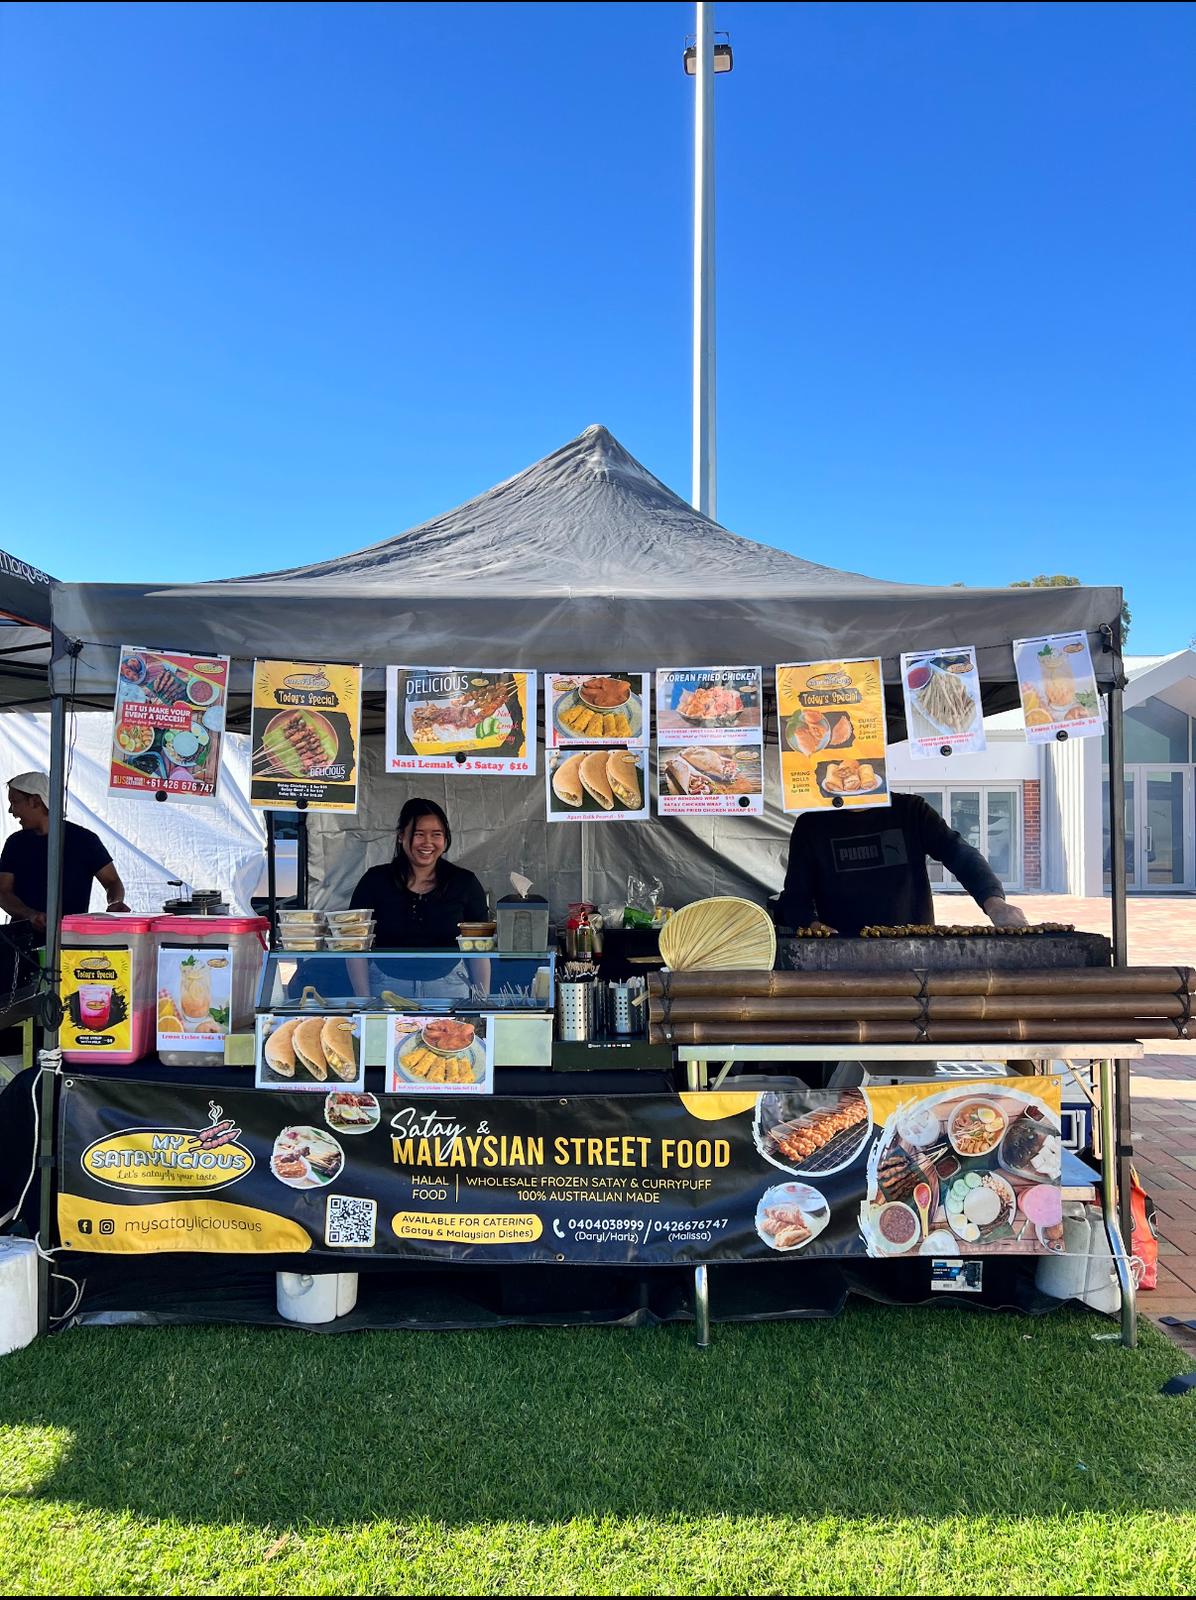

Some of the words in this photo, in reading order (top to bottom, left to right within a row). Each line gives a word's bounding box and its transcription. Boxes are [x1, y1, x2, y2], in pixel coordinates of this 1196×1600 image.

[663, 673, 696, 682] KOREAN
[697, 673, 721, 682] FRIED
[722, 672, 757, 681] CHICKEN
[406, 675, 469, 695] DELICIOUS
[278, 691, 305, 705] Today's
[308, 692, 335, 706] Special
[803, 693, 829, 705] Today's
[831, 691, 858, 704] Special
[125, 703, 138, 712] LET
[149, 706, 169, 714] MAKE
[170, 708, 191, 716] YOUR
[124, 711, 147, 719] EVENT
[149, 712, 154, 720] A
[155, 713, 186, 723] SUCCESS!
[309, 766, 346, 777] DELICIOUS
[392, 759, 416, 769] Nasi
[418, 759, 454, 769] Lemak
[465, 761, 472, 770] 3
[474, 760, 504, 772] Satay
[509, 762, 529, 770] $16
[146, 779, 160, 788] +61
[163, 780, 179, 790] 426
[182, 781, 197, 791] 676
[199, 783, 214, 793] 747
[839, 845, 879, 861] PUMA
[76, 970, 95, 979] Today's
[97, 970, 115, 979] Special
[390, 1107, 467, 1161] Satay
[476, 1120, 491, 1135] &
[152, 1135, 185, 1151] MY
[392, 1135, 544, 1168] MALAYSIAN
[554, 1135, 652, 1168] STREET
[661, 1138, 731, 1169] FOOD
[91, 1149, 247, 1170] SATAYLICIOUS
[117, 1169, 138, 1180] Let's
[411, 1175, 450, 1186] HALAL
[465, 1176, 538, 1187] WHOLESALE
[540, 1176, 589, 1188] FROZEN
[591, 1177, 628, 1188] SATAY
[630, 1178, 639, 1189] &
[642, 1179, 712, 1190] CURRYPUFF
[412, 1189, 447, 1201] FOOD
[517, 1190, 547, 1201] 100%
[549, 1190, 623, 1202] AUSTRALIAN
[626, 1192, 660, 1203] MADE
[124, 1215, 262, 1234] mysatayliciousaus
[402, 1215, 456, 1226] AVAILABLE
[459, 1217, 480, 1226] FOR
[483, 1217, 534, 1226] CATERING
[568, 1218, 644, 1231] 0404038999
[654, 1218, 729, 1232] 0426676747
[400, 1226, 434, 1236] (Satay
[436, 1228, 443, 1236] &
[446, 1229, 496, 1241] Malaysian
[498, 1229, 534, 1239] Dishes)
[574, 1231, 639, 1244] (Daryl/Hariz)
[668, 1231, 712, 1242] (Malissa)
